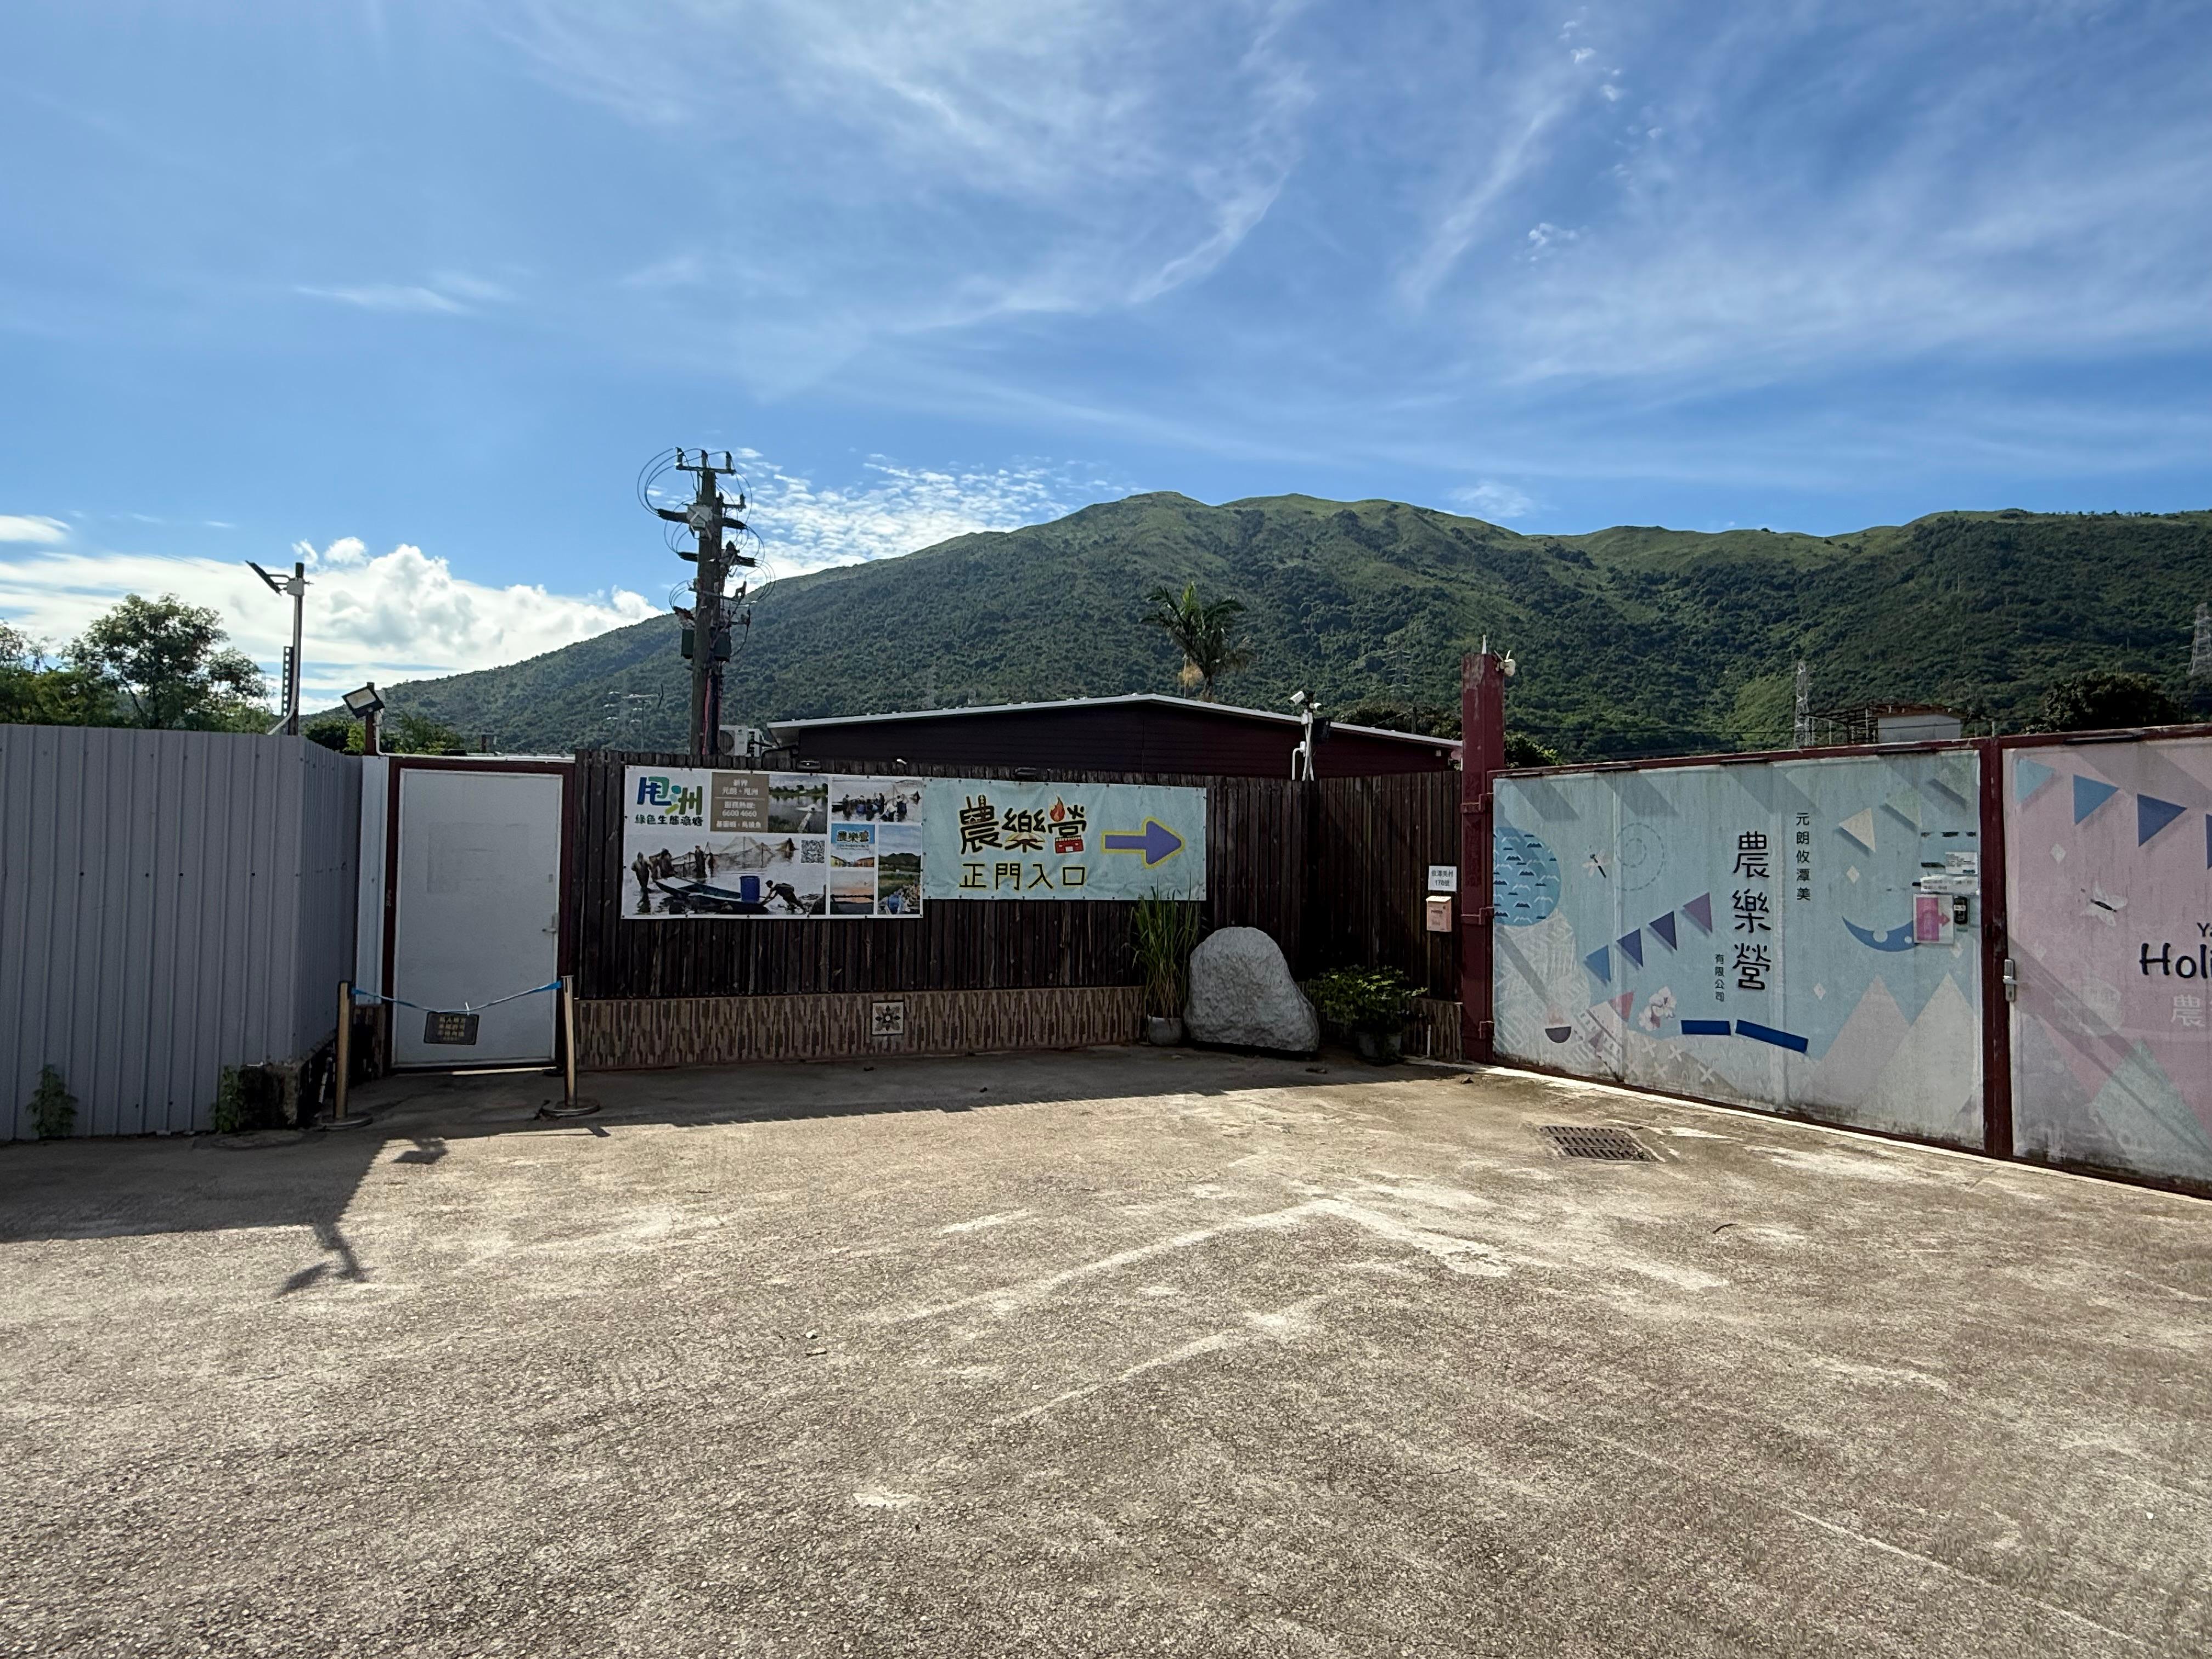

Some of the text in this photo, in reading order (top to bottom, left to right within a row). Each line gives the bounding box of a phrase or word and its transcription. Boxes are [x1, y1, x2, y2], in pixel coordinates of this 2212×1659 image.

[959, 795, 1087, 855] 農樂營
[959, 863, 1086, 890] 正門入口
[1796, 812, 1810, 901] 元朗攸潭美
[1732, 831, 1771, 990] 農樂營
[2197, 922, 2212, 937] Y
[1715, 953, 1725, 1002] 有限公司
